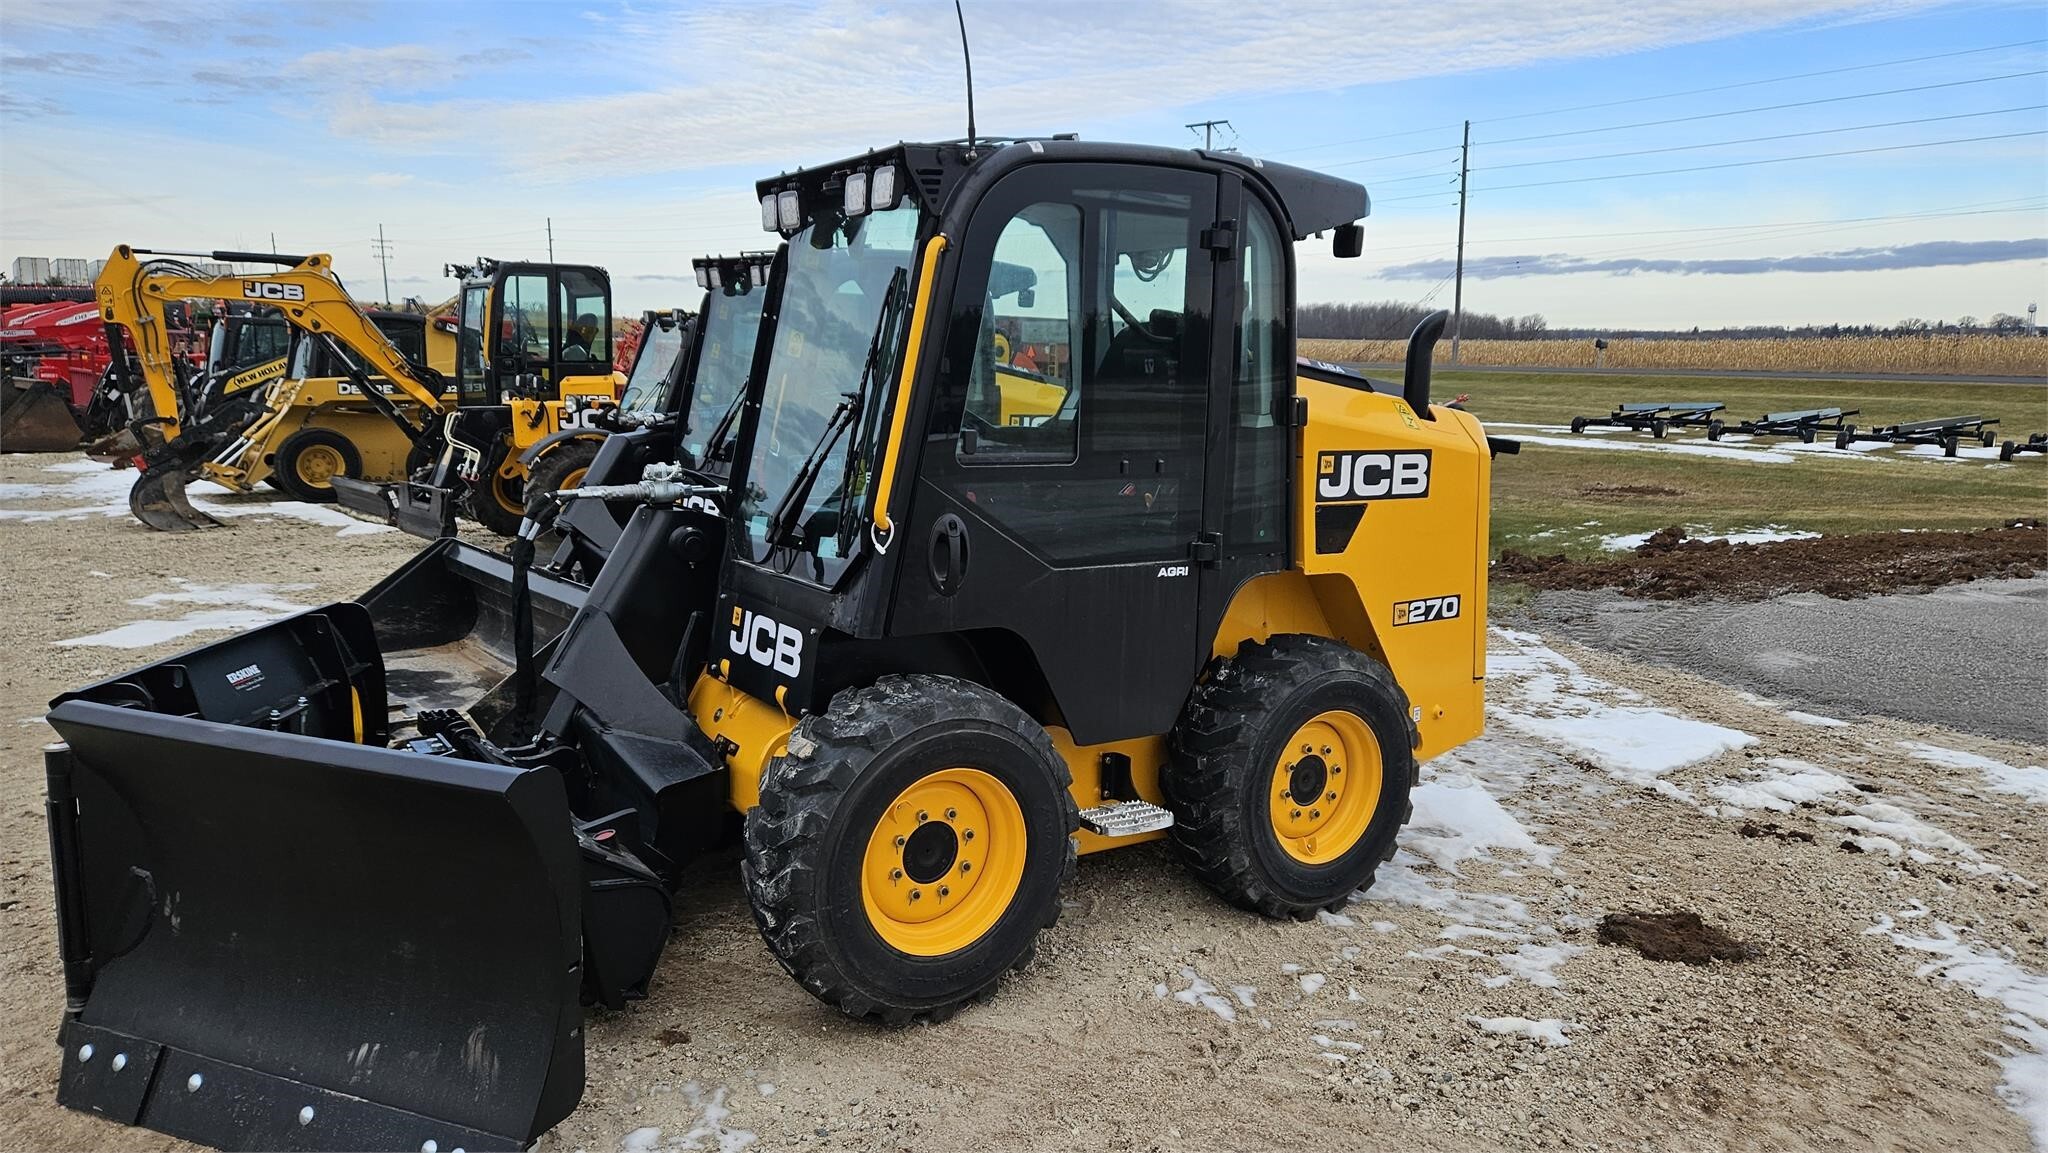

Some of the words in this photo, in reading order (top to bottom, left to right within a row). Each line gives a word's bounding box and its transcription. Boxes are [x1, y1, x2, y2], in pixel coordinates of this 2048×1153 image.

[244, 282, 304, 300] JCB
[1318, 361, 1346, 374] USA
[236, 372, 257, 385] NEW
[559, 408, 617, 430] JC
[1319, 454, 1428, 498] JCB
[1157, 566, 1189, 578] AGRI
[1408, 596, 1459, 623] 270
[729, 609, 804, 678] JCB
[225, 664, 262, 684] ERSKINE
